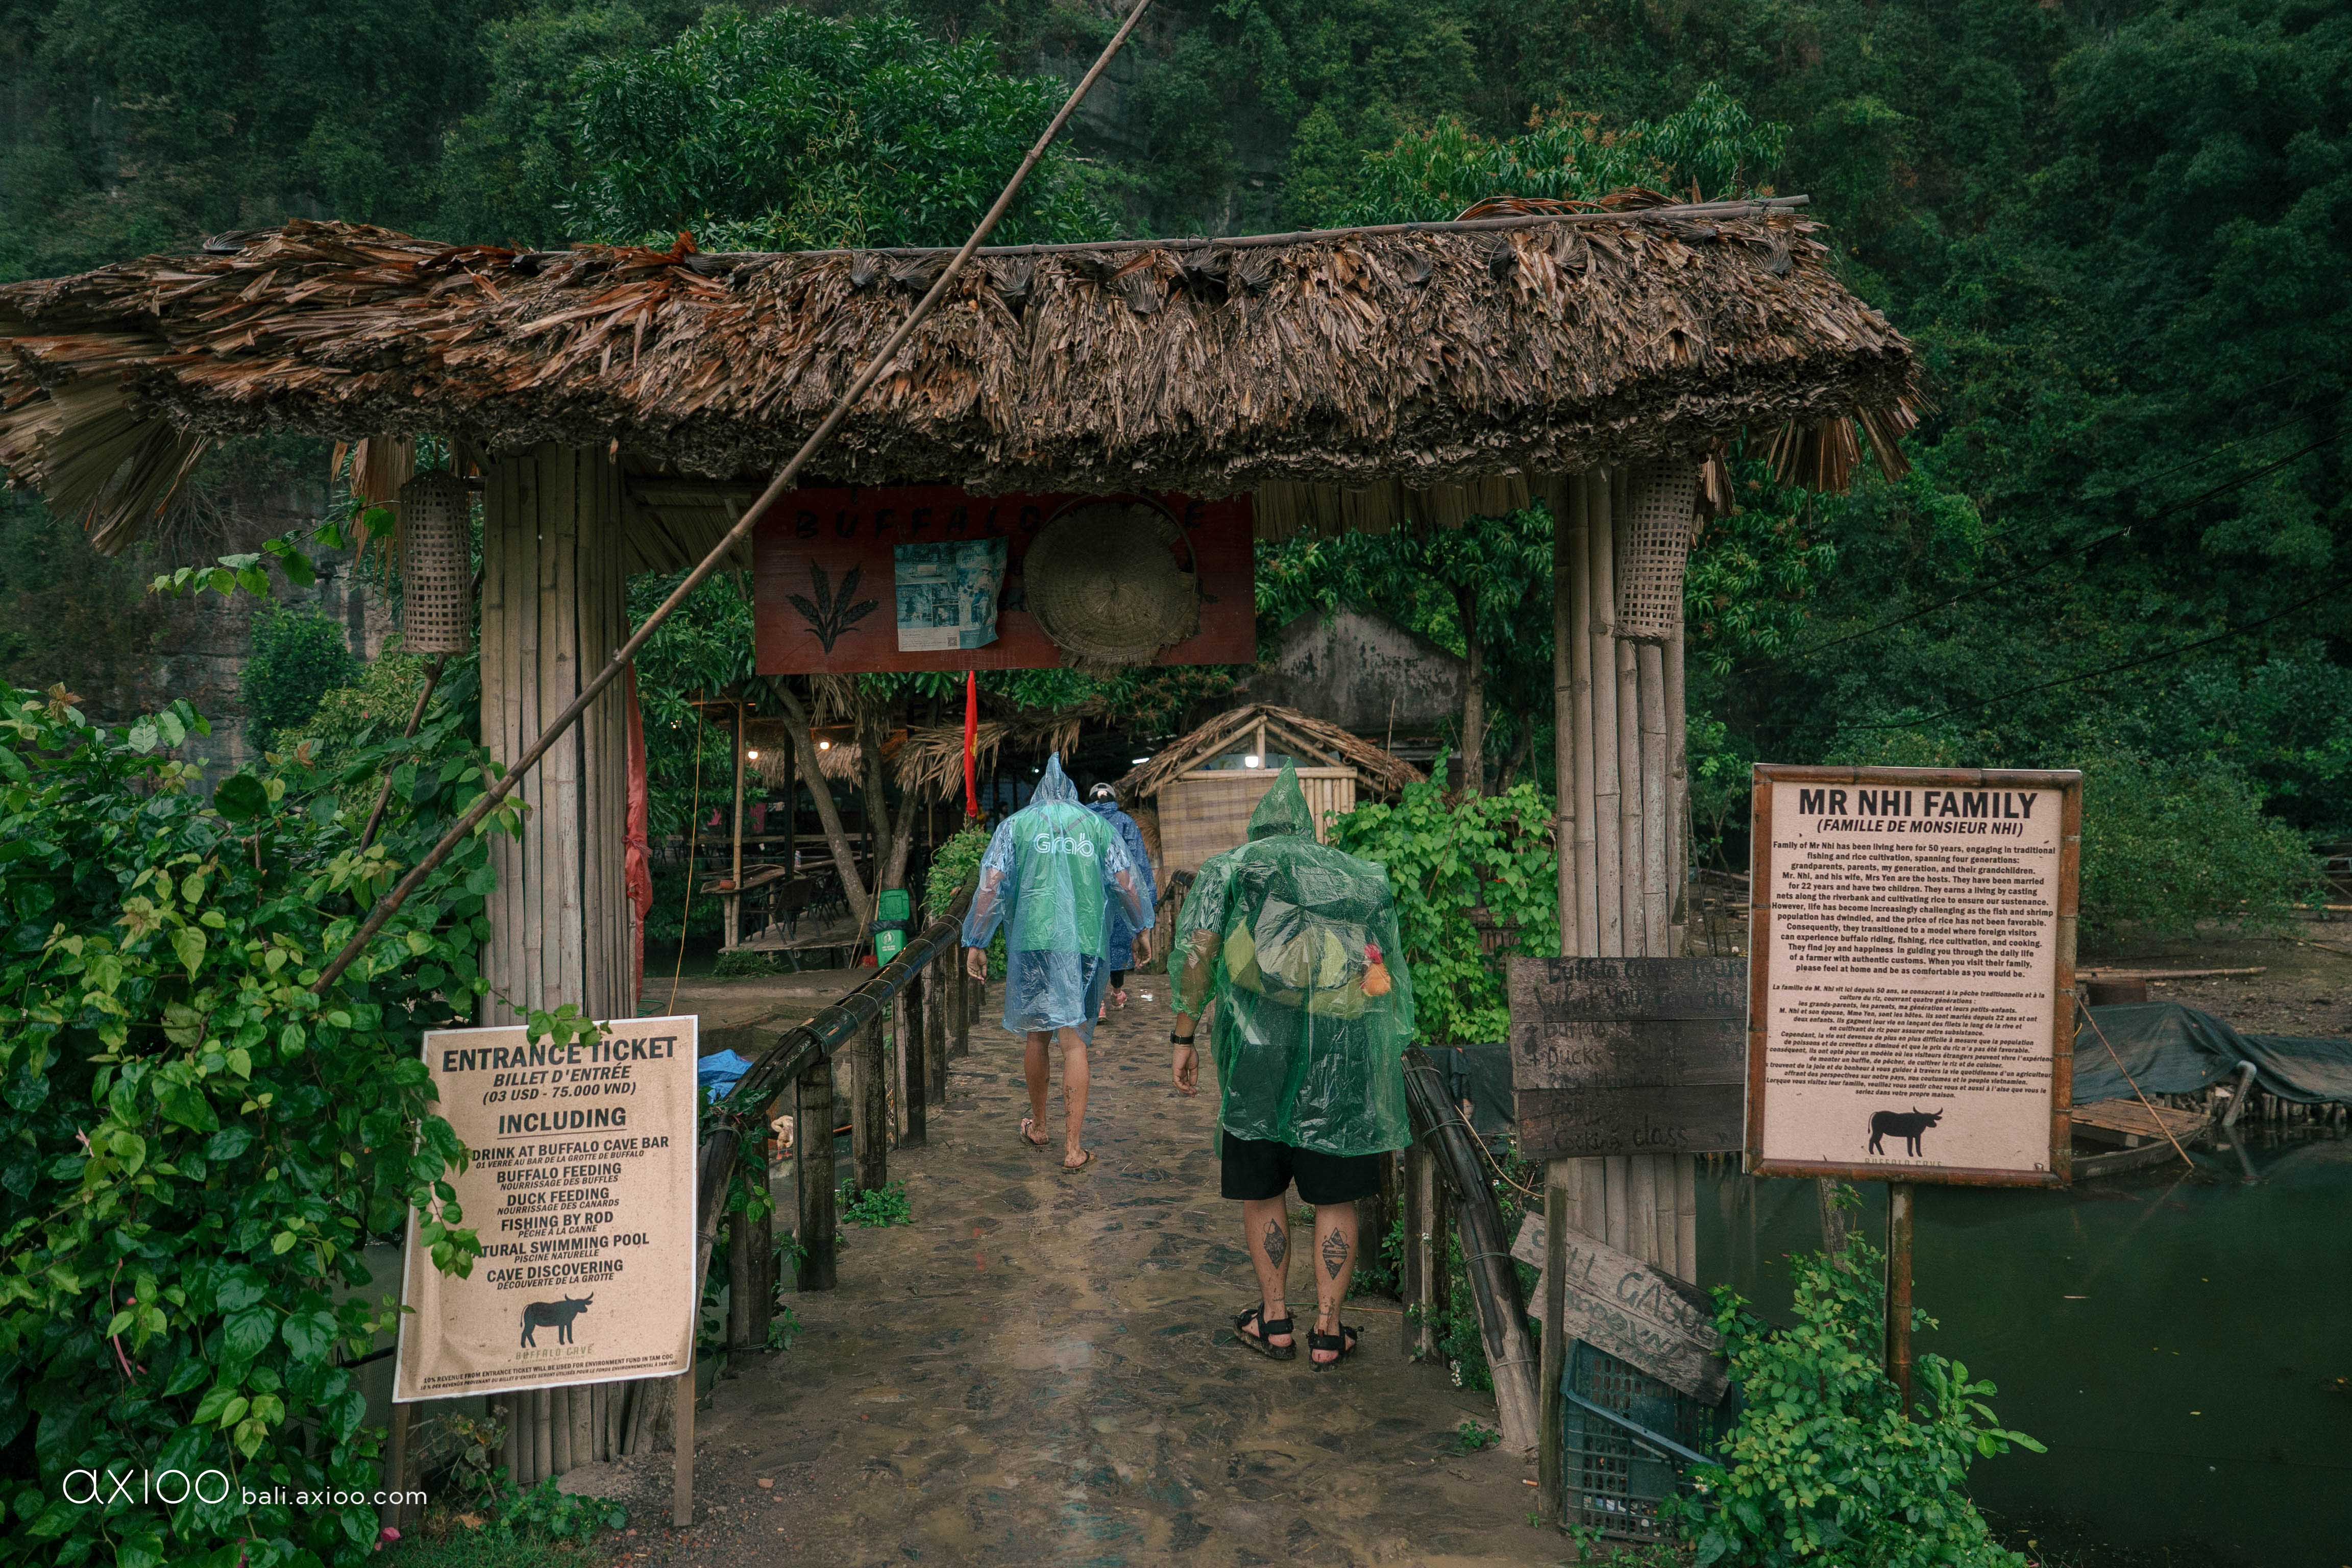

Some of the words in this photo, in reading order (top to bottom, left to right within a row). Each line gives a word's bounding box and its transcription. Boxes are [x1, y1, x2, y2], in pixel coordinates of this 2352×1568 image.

[1799, 789, 1848, 815] MR
[1858, 790, 1912, 816] NHI
[1924, 791, 2038, 819] FAMILY
[1817, 819, 1884, 832] (FAMILLE
[1886, 820, 1907, 832] DE
[1909, 821, 1987, 834] MONSIEUR
[1991, 822, 2023, 837] NHI)
[1034, 832, 1094, 857] Grab
[1773, 841, 1797, 849] Family
[1873, 843, 1894, 852] living
[1966, 846, 2002, 854] engaging
[1791, 862, 1845, 871] grandparents,
[1807, 852, 1833, 861] fishing
[1869, 853, 1912, 862] cultivation,
[1915, 855, 1950, 864] spanning
[1797, 872, 1812, 880] Nhi,
[1844, 873, 1863, 881] wife,
[1952, 876, 1970, 885] They
[1796, 964, 1821, 972] please
[443, 1043, 581, 1072] ENTRANCE
[592, 1037, 677, 1062] TICKET
[493, 1070, 549, 1086] BILLET
[551, 1063, 631, 1083] D'ENTRÉE
[483, 1090, 507, 1105] (03
[511, 1088, 539, 1100] USD
[552, 1084, 600, 1097] 75.000
[604, 1082, 636, 1095] VND)
[499, 1107, 626, 1134] INCLUDING
[472, 1146, 515, 1161] DRINK
[518, 1145, 535, 1157] AT
[538, 1141, 599, 1156] BUFFALO
[603, 1138, 638, 1151] CAVE
[642, 1136, 669, 1148] BAR
[488, 1159, 512, 1167] VERRE
[610, 1150, 644, 1158] BUFFALO
[497, 1167, 558, 1183] BUFFALO
[563, 1162, 621, 1178] FEEDING
[500, 1179, 561, 1190] NOURRISSAGE
[564, 1178, 579, 1186] DES
[582, 1174, 618, 1184] BUFFLES
[507, 1192, 546, 1206] DUCK
[550, 1187, 609, 1203] FEEDING
[497, 1203, 558, 1215] NOURRISSAGE
[579, 1198, 619, 1208] CANARDS
[501, 1215, 558, 1231] FISHING
[564, 1213, 581, 1226] BY
[585, 1211, 613, 1224] ROD
[518, 1227, 547, 1238] PÊCHE
[548, 1226, 555, 1235] À
[569, 1224, 598, 1234] CANNE
[530, 1236, 608, 1253] SWIMMING
[614, 1233, 649, 1246] POOL
[514, 1253, 549, 1263] PISCINE
[551, 1249, 599, 1260] NATURELLE
[1527, 1229, 1597, 1286] SLL
[487, 1267, 523, 1282] CAVE
[527, 1259, 623, 1279] DISCOVERING
[497, 1276, 555, 1290] DÉCOUVERTE
[555, 1277, 567, 1285] DE
[569, 1276, 579, 1284] LA
[582, 1272, 614, 1282] GROTTE
[567, 1345, 593, 1355] CAVE
